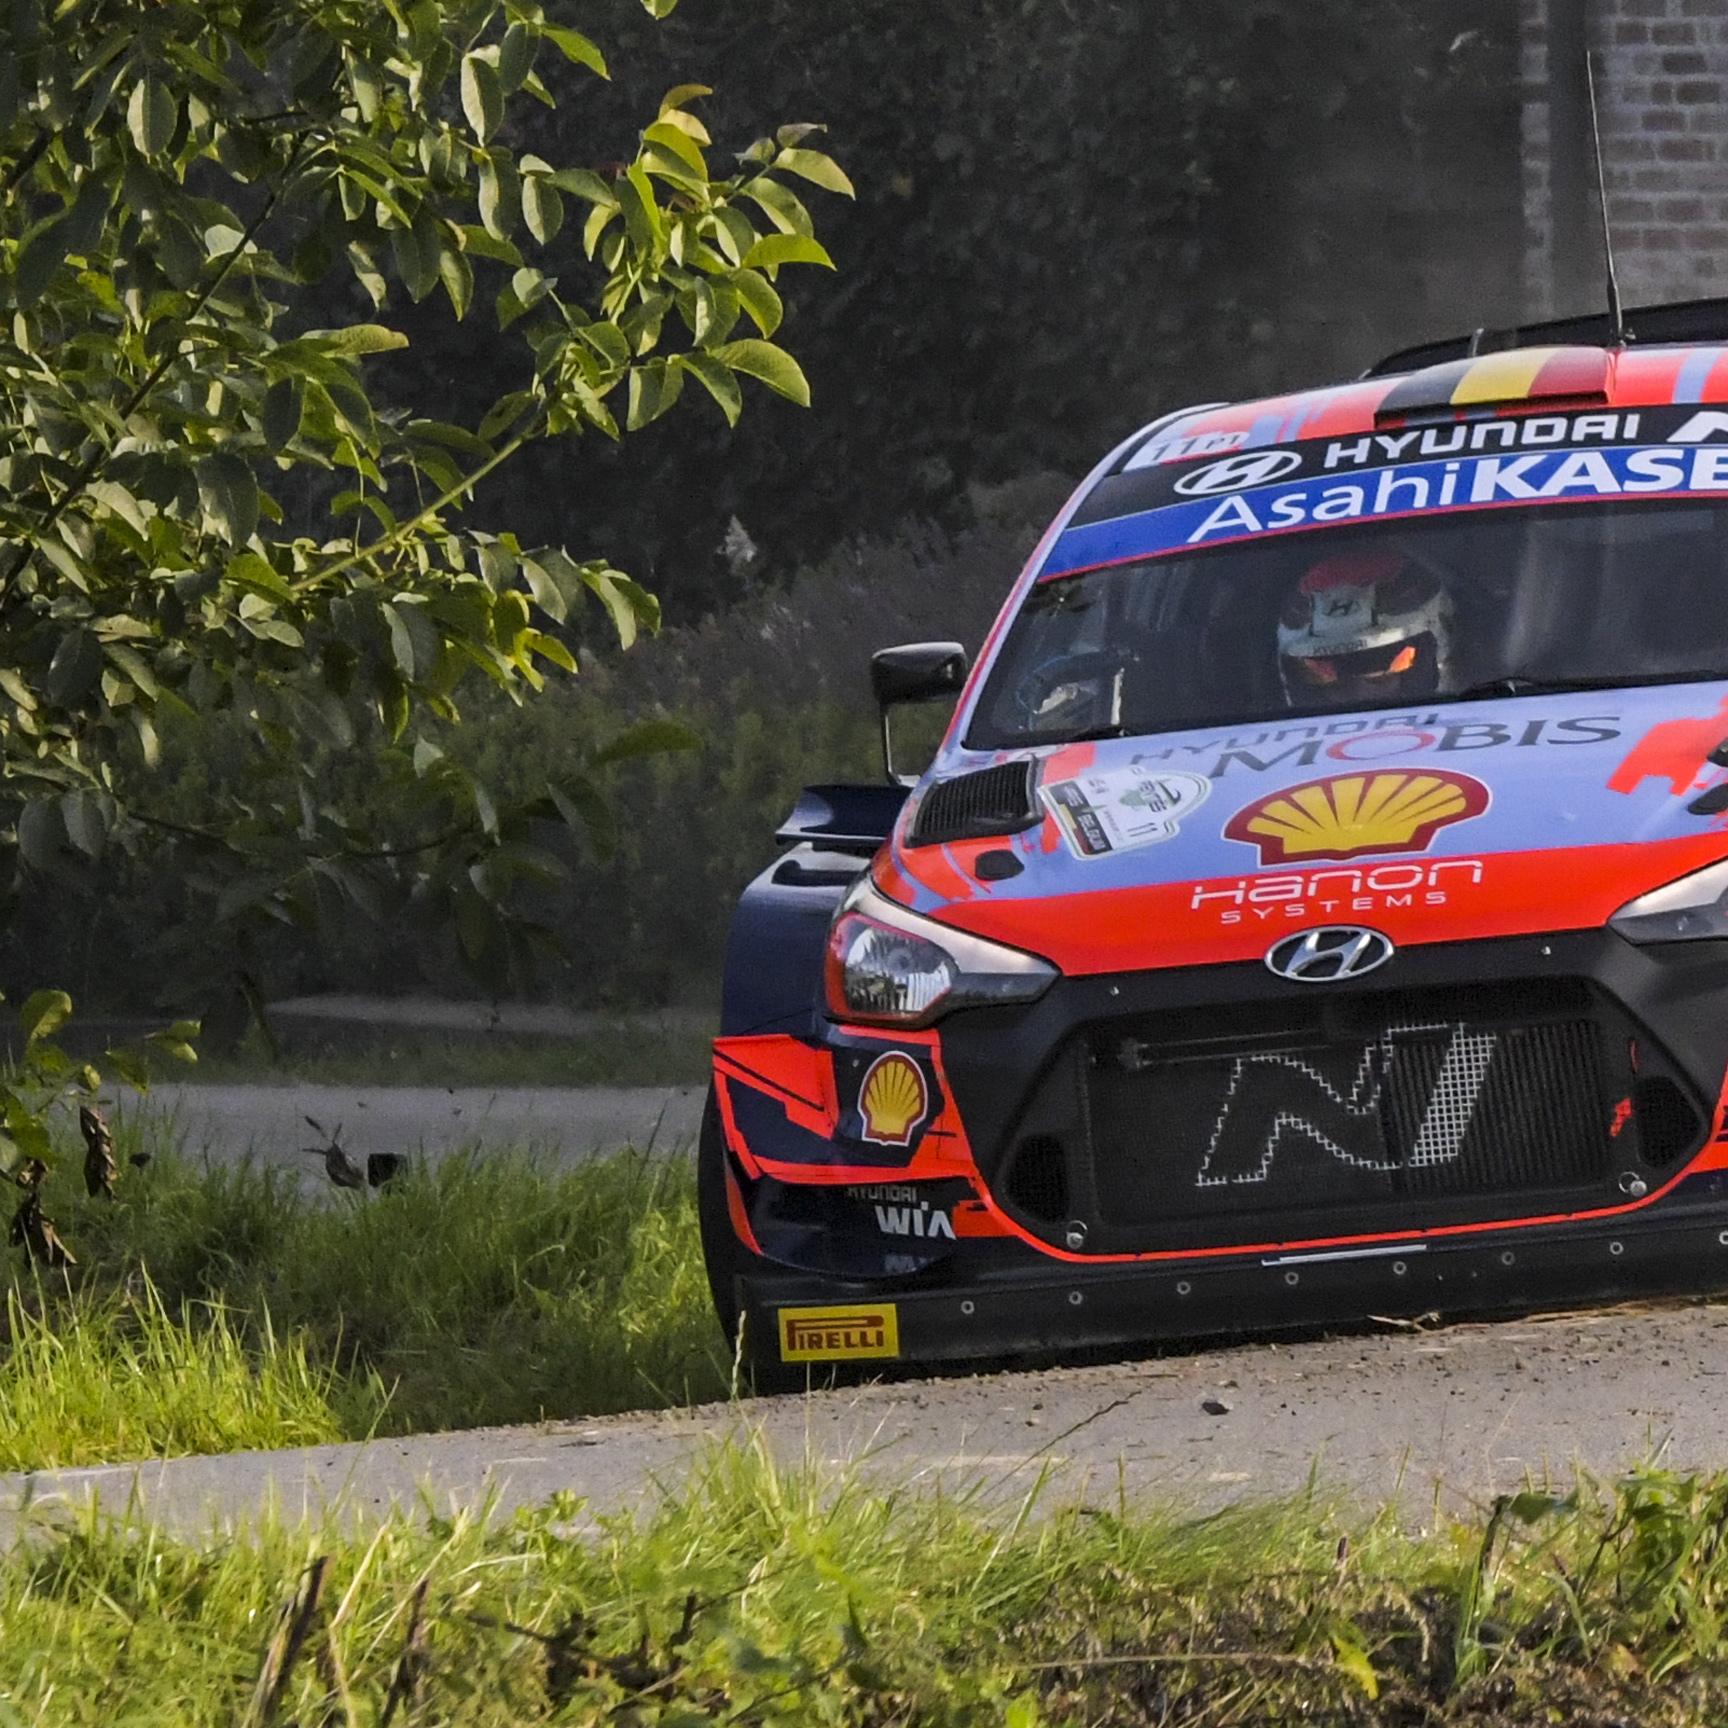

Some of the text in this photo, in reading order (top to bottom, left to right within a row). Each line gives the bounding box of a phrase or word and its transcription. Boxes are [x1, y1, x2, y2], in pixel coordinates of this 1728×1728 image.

[1323, 413, 1641, 468] HYUNDAI
[1130, 713, 1440, 766] HYUNDAI
[1209, 716, 1622, 779] MOBIS
[1220, 891, 1448, 925] SYSTEMS
[786, 1314, 884, 1351] PIRELLI
